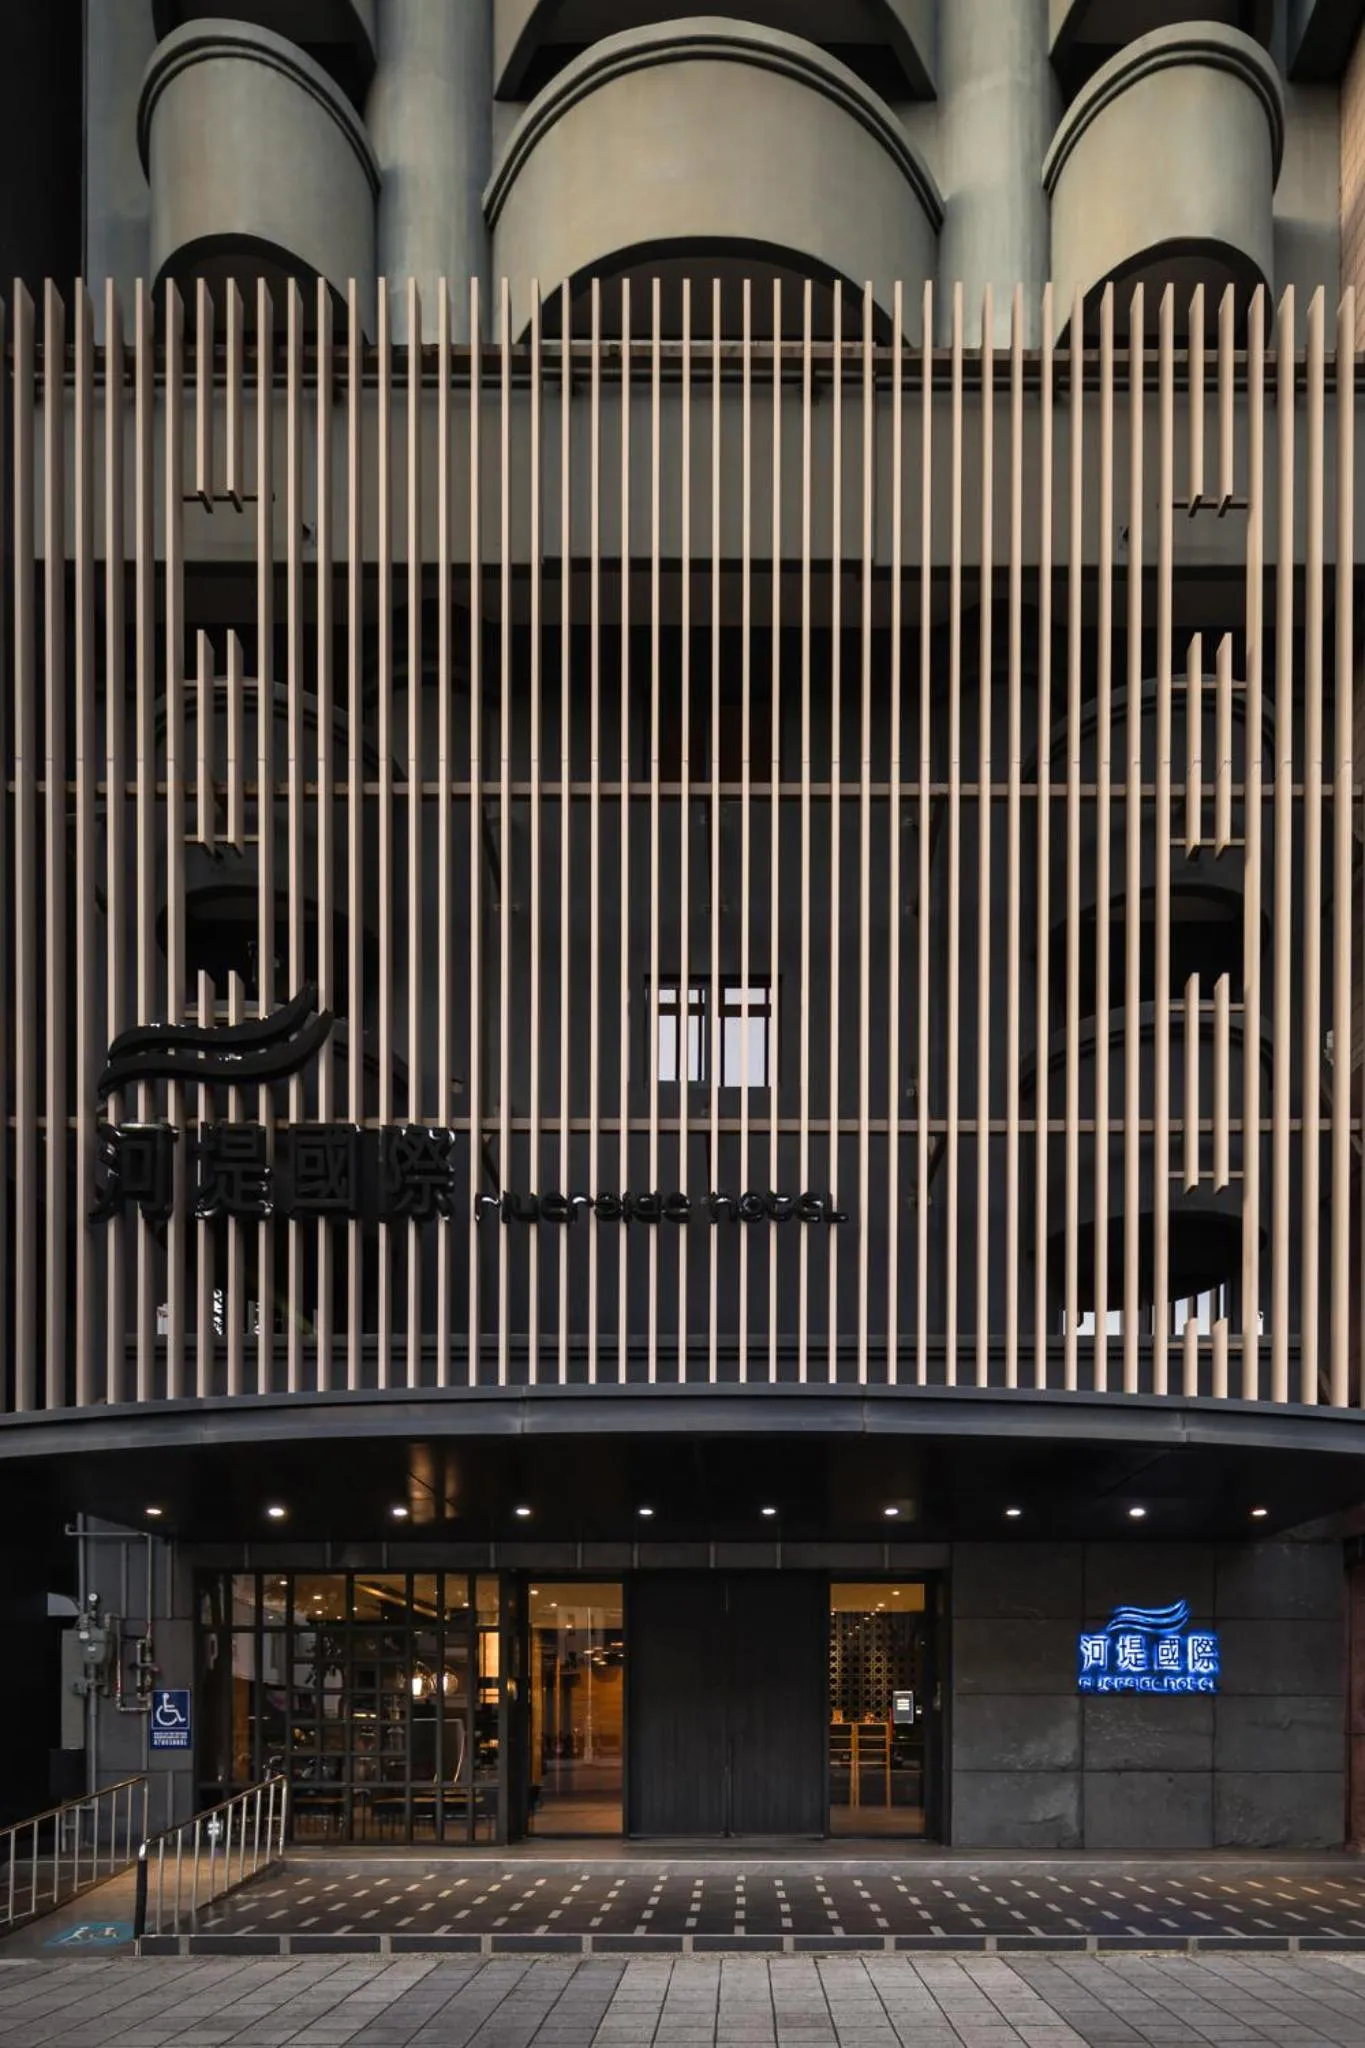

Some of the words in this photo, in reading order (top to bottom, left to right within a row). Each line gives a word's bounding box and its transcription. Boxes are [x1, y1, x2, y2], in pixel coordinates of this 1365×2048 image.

[92, 1122, 455, 1221] 河堤國際
[1079, 1633, 1219, 1674] 河堤國際
